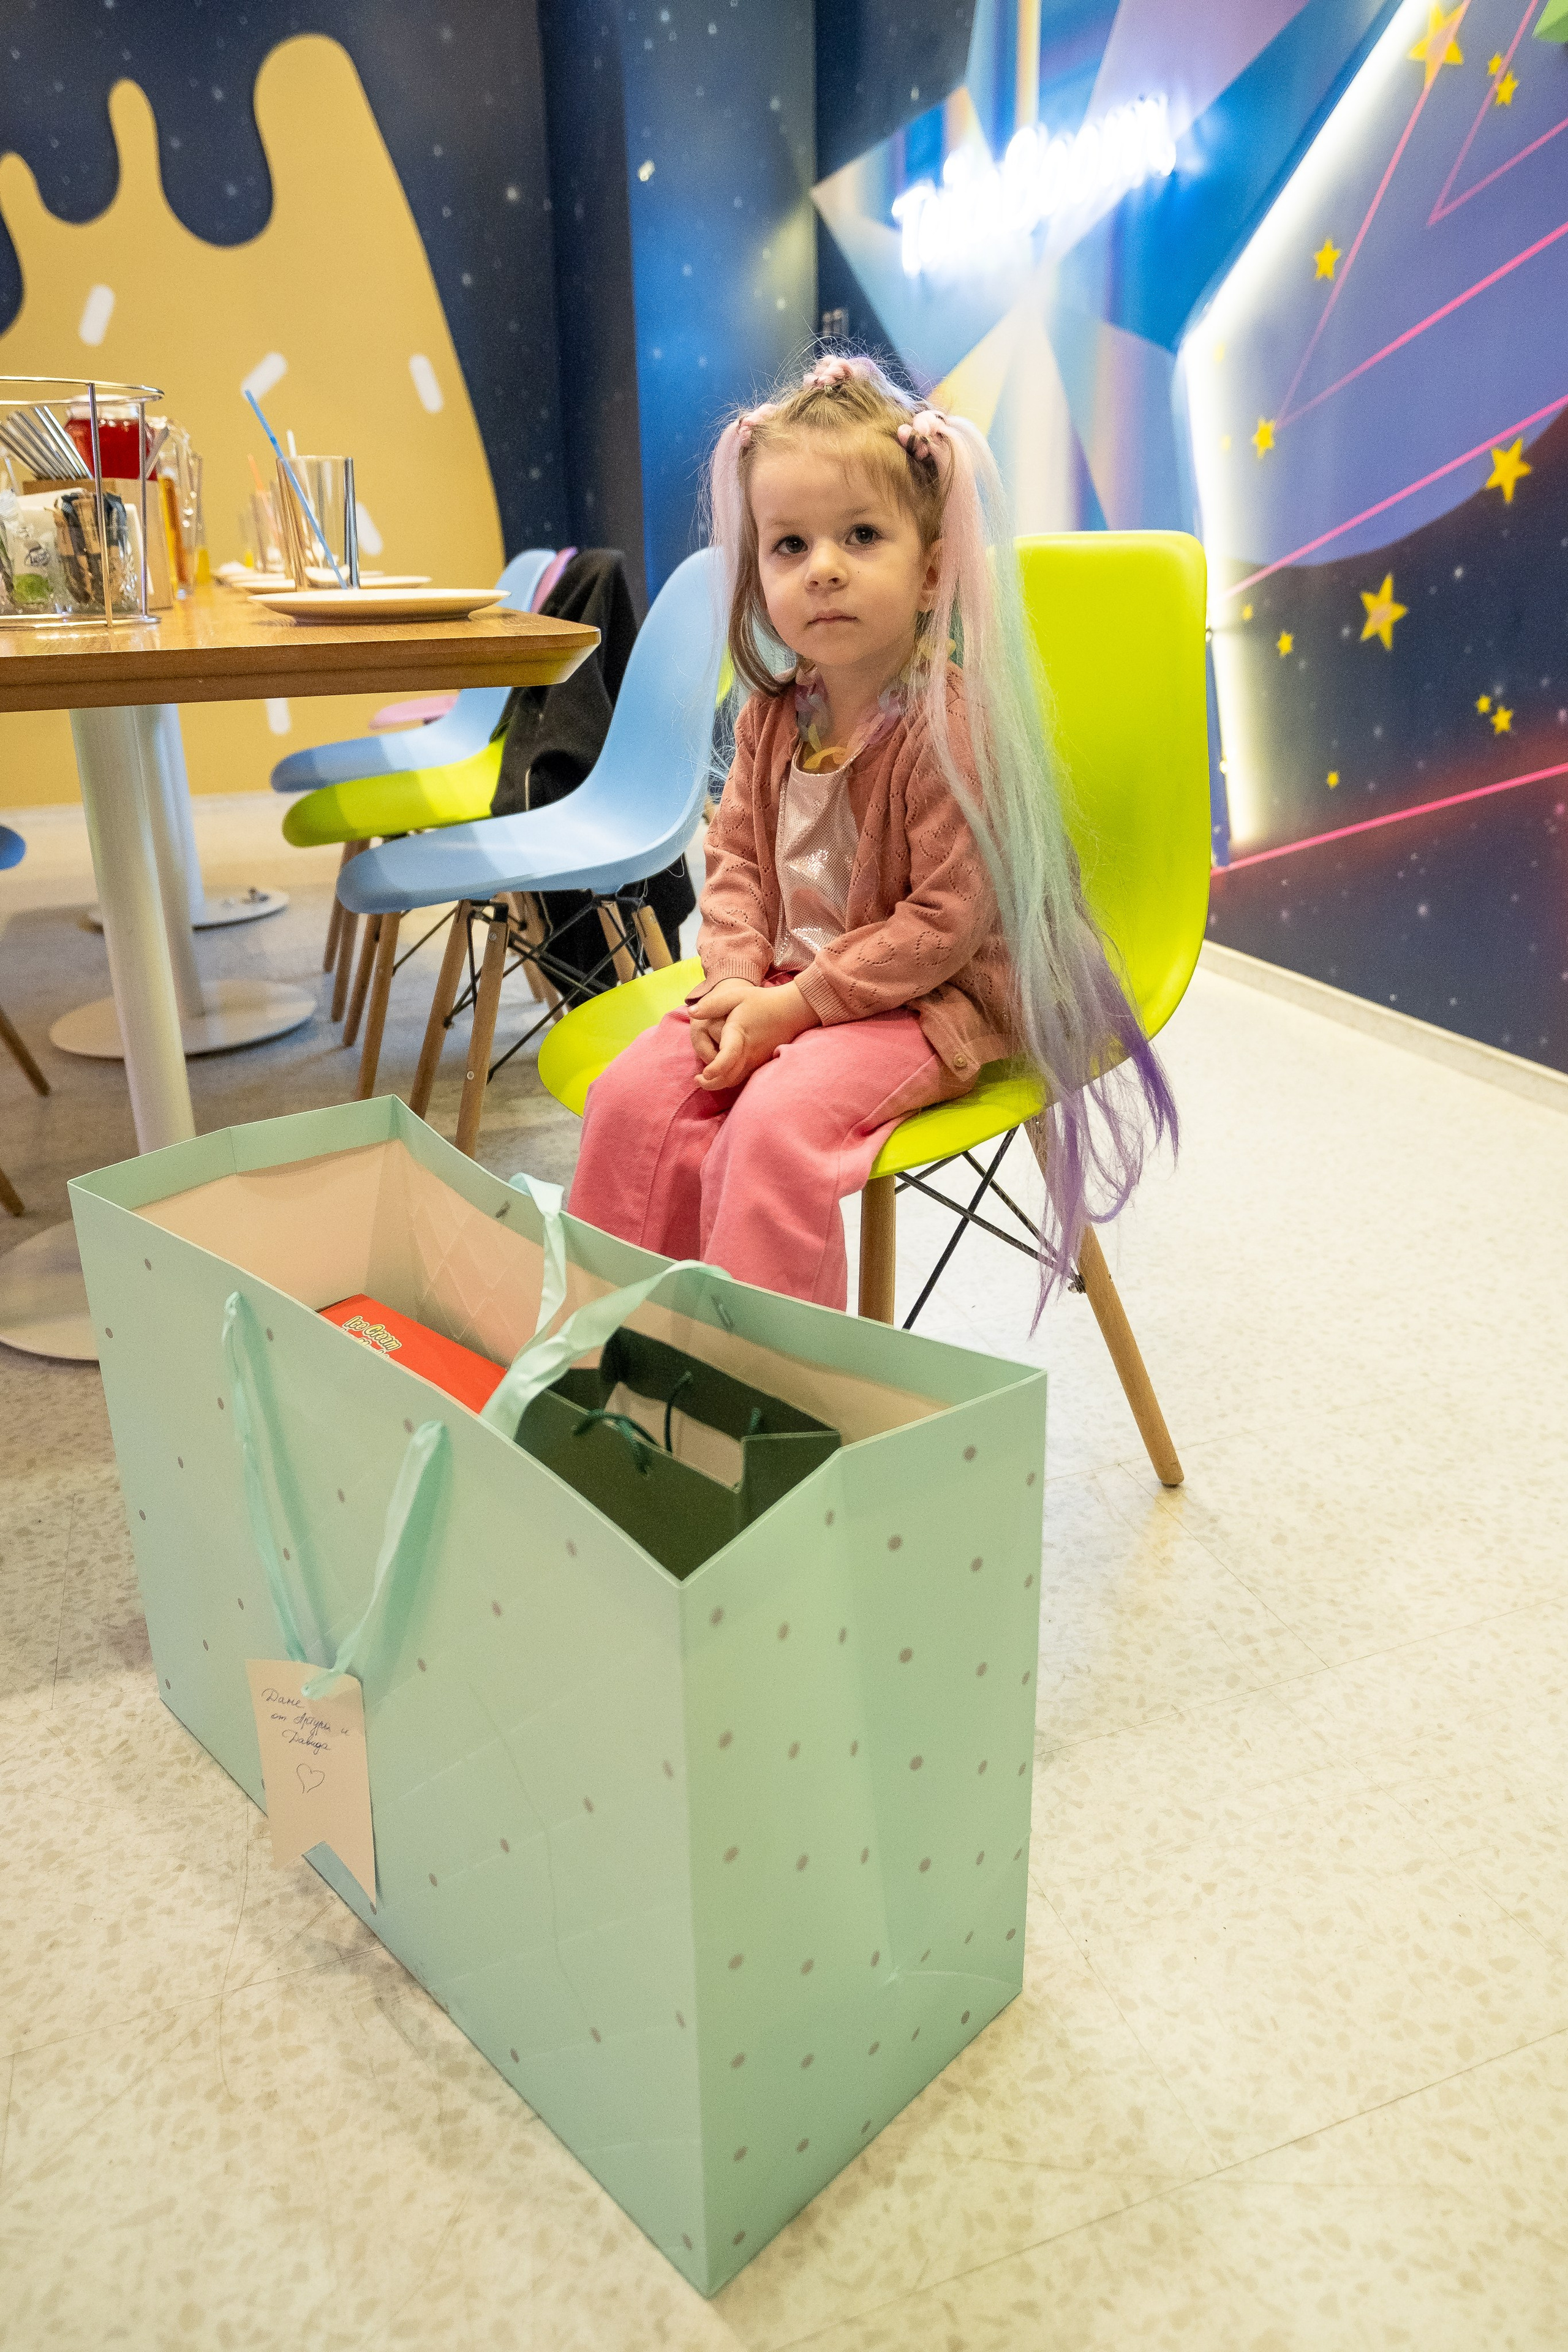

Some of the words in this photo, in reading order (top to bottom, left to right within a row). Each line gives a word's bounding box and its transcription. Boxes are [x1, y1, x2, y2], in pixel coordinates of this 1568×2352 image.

[342, 1315, 370, 1330] Ice
[362, 1324, 402, 1352] Cream
[262, 1687, 304, 1709] Дане
[282, 1728, 331, 1755] Давида
[341, 1727, 350, 1736] и
